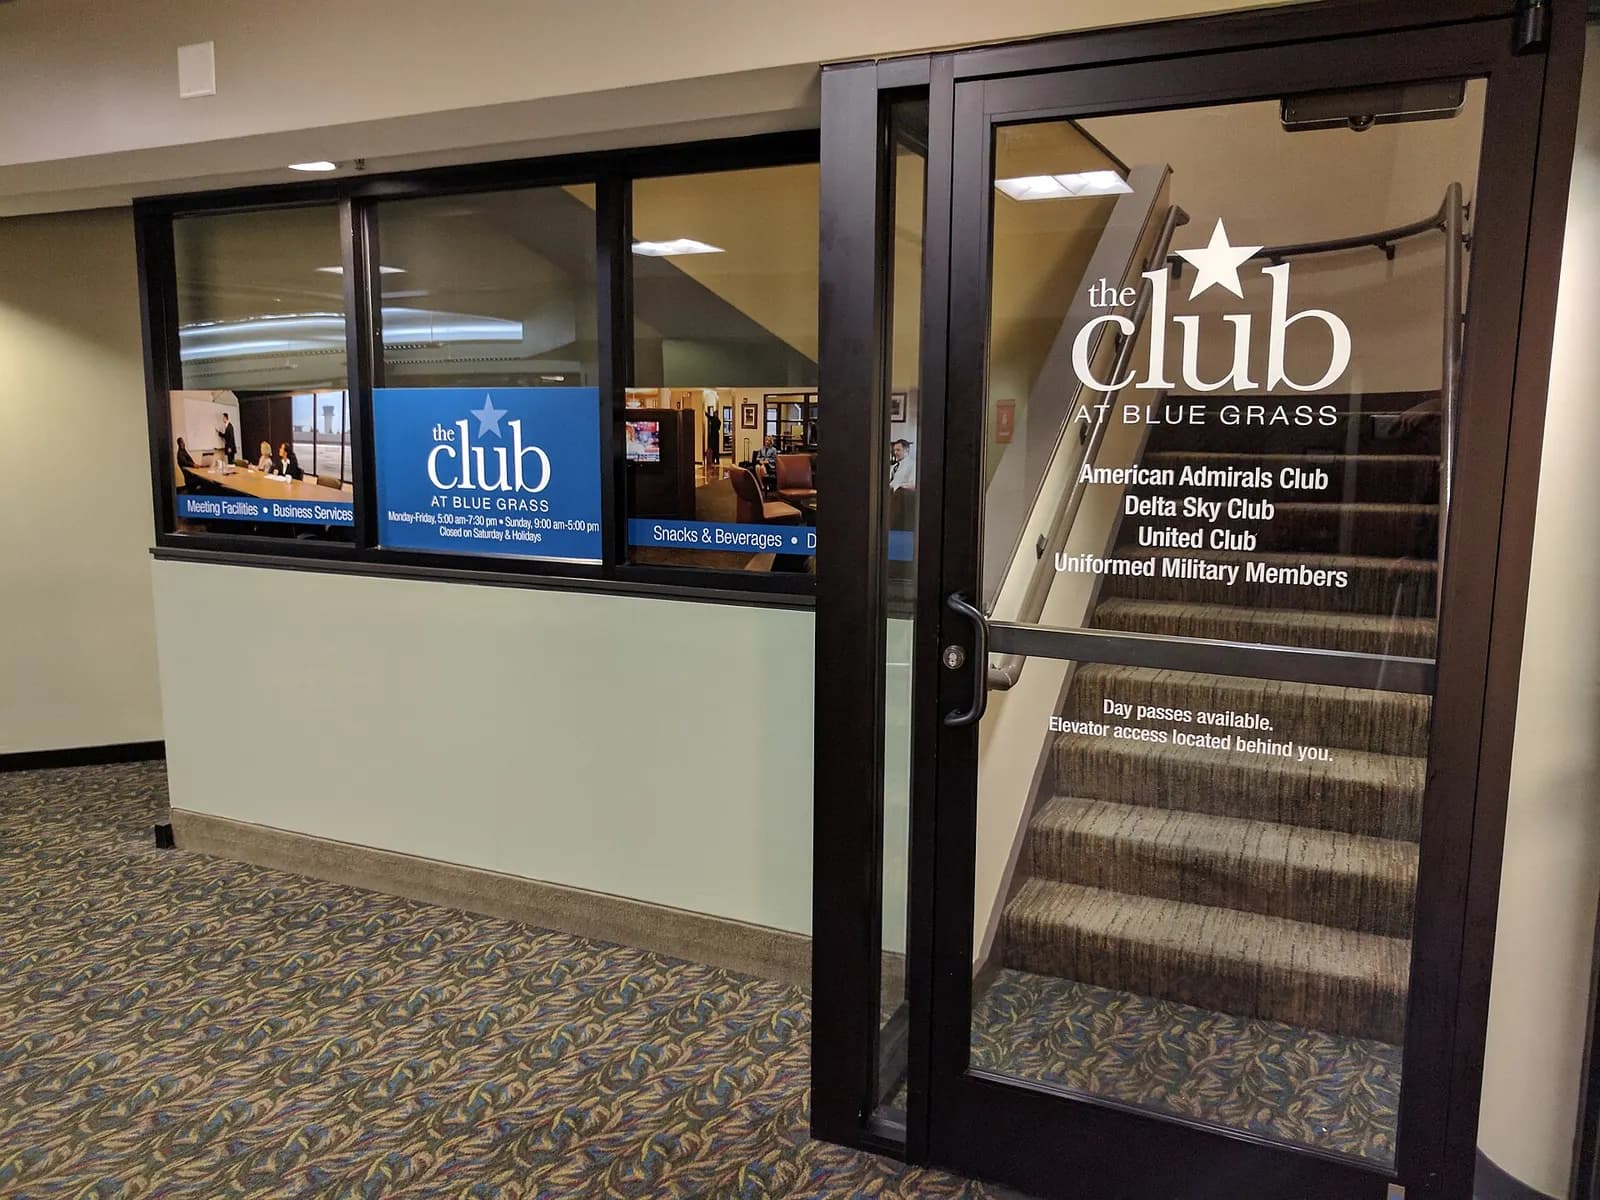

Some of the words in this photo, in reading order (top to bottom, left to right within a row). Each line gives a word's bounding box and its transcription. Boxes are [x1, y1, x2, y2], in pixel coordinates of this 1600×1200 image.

[1087, 278, 1137, 308] the
[1072, 262, 1352, 392] club
[1074, 405, 1110, 424] AT
[1123, 405, 1206, 425] BLUE
[1220, 405, 1337, 426] GRASS
[432, 423, 455, 441] the
[427, 419, 551, 493] club
[1079, 463, 1174, 486] American
[1178, 465, 1273, 488] Admirals
[1279, 468, 1329, 490] Club
[187, 499, 221, 517] Meeting
[222, 502, 259, 516] Facilities
[273, 503, 313, 519] Business
[314, 506, 353, 521] Services
[431, 496, 447, 508] AT
[453, 497, 491, 510] BLUE
[496, 498, 549, 512] GRASS
[1125, 495, 1176, 517] Delta
[1183, 496, 1221, 523] Sky
[1227, 498, 1275, 521] Club
[387, 511, 436, 525] Monday-Friday,
[437, 513, 454, 524] 5:00
[455, 515, 484, 526] am-7:30
[486, 517, 497, 528] pm
[505, 516, 533, 530] Sunday,
[534, 518, 551, 529] 9:00
[553, 520, 586, 531] am-5:00
[587, 522, 600, 533] pm
[440, 526, 462, 537] Closed
[463, 530, 472, 538] on
[473, 528, 503, 541] Saturday
[504, 530, 511, 540] &
[512, 530, 542, 543] Holidays
[653, 525, 698, 543] Snacks
[701, 528, 713, 544] &
[715, 528, 783, 549] Beverages
[1138, 527, 1203, 549] United
[1210, 529, 1257, 552] Club
[1054, 553, 1155, 577] Uniformed
[1161, 558, 1239, 586] Military
[1245, 562, 1348, 589] Members
[1103, 699, 1133, 719] Day
[1137, 704, 1192, 723] passes
[1197, 710, 1274, 731] available.
[1049, 716, 1110, 737] Elevator
[1113, 726, 1168, 743] access
[1172, 729, 1231, 750] located
[1236, 736, 1292, 758] behind
[1297, 745, 1334, 762] you.
